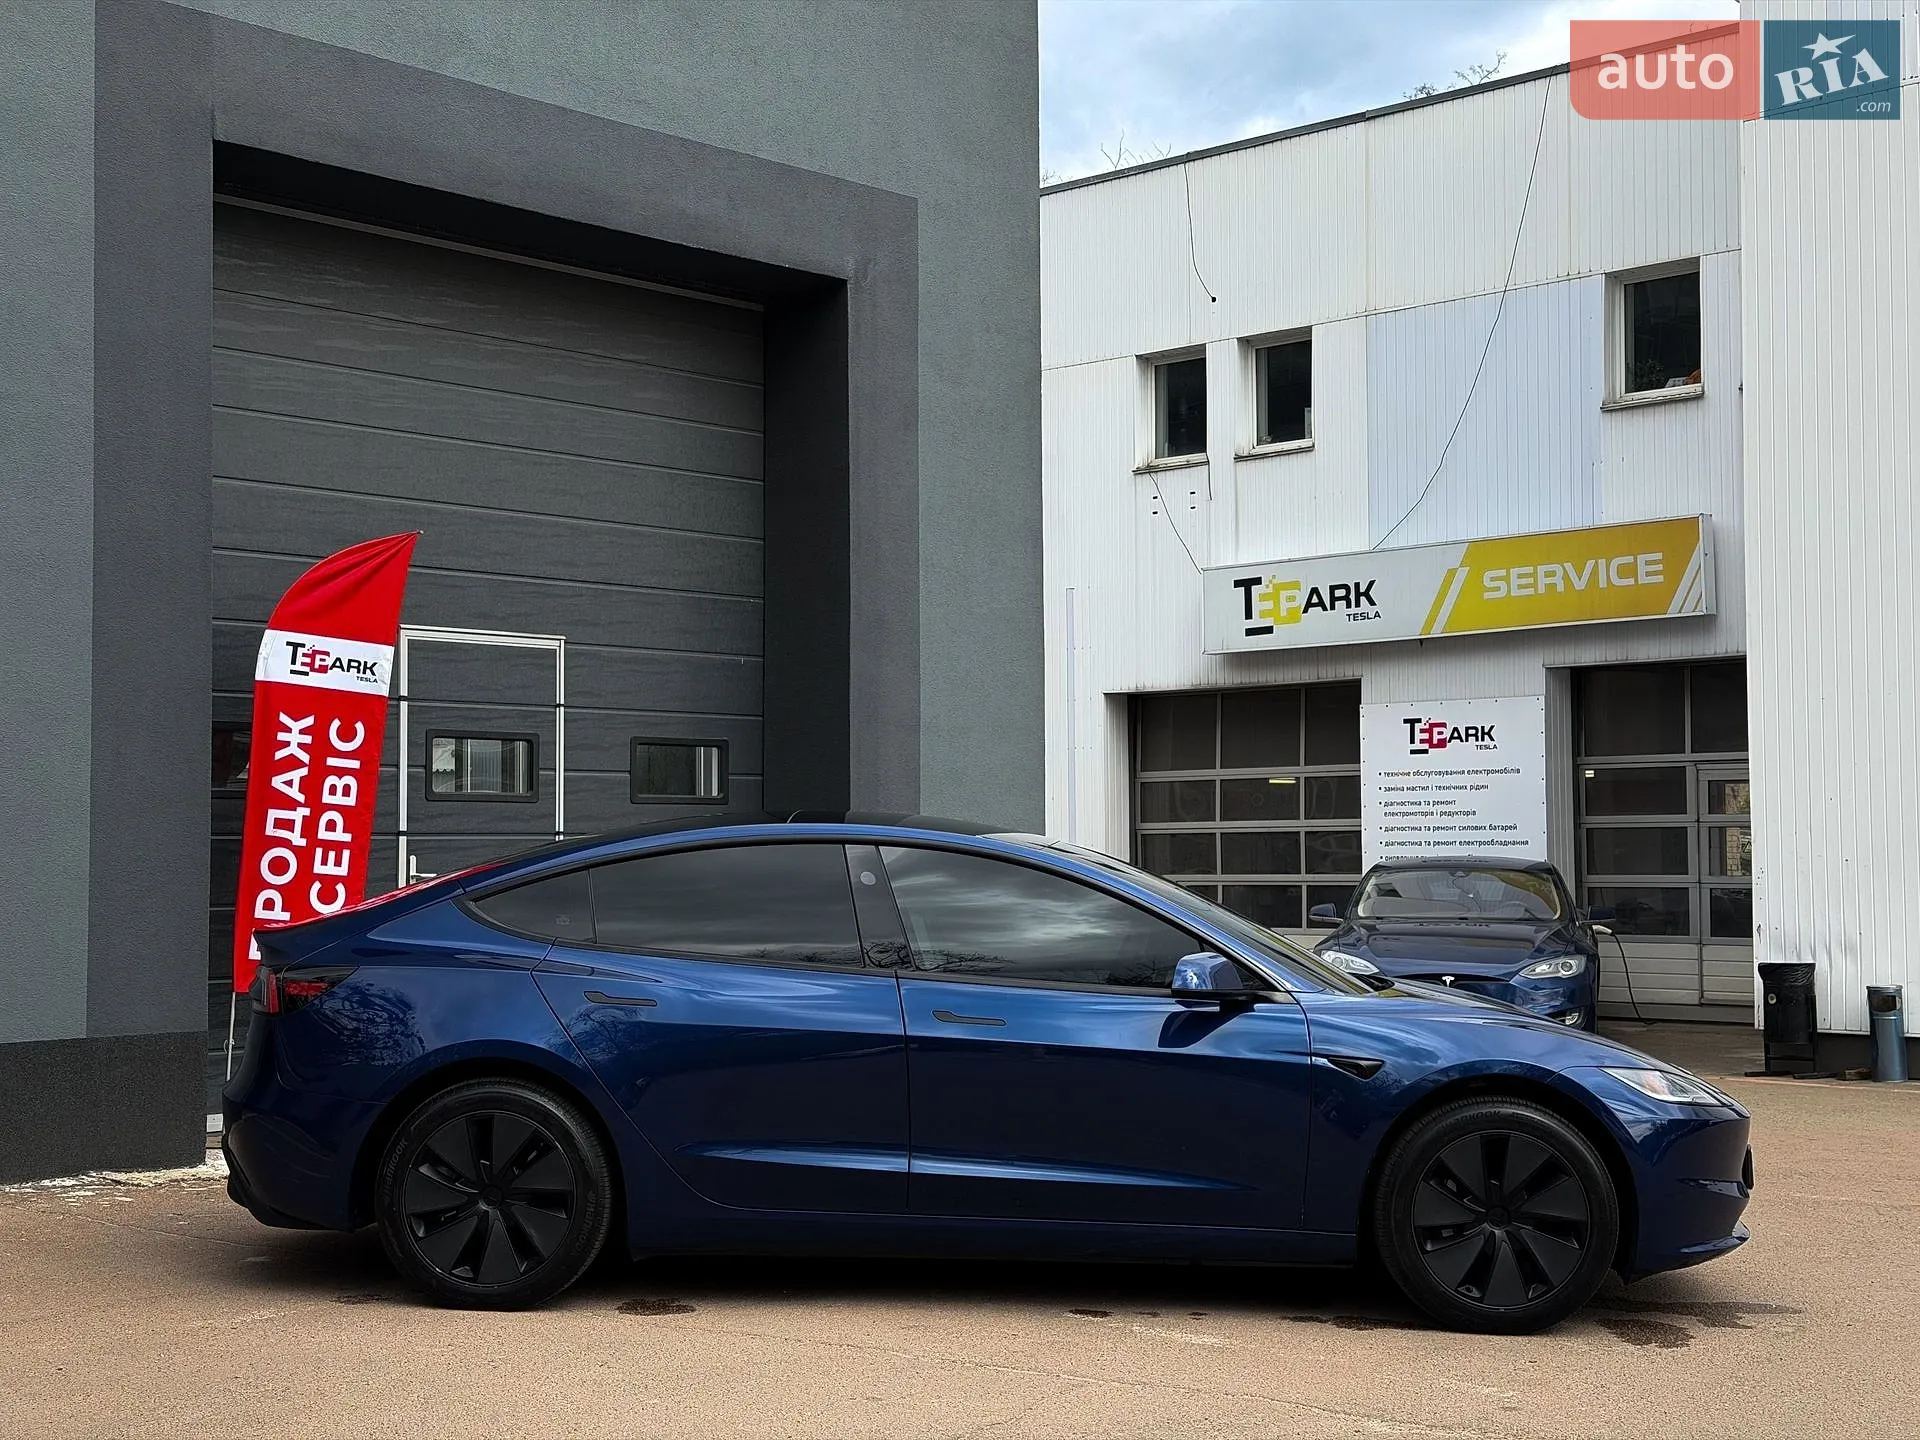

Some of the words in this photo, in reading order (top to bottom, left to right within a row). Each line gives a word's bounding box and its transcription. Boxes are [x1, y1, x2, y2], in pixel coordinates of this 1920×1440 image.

[1483, 552, 1664, 600] SERVICE
[1345, 610, 1381, 622] TESLA
[356, 674, 379, 684] TESLA
[1384, 770, 1411, 778] технічне
[1412, 768, 1466, 778] обслуговування
[1466, 767, 1521, 777] електромобілів
[1406, 784, 1430, 792] мастил
[1435, 783, 1468, 792] технічних
[1469, 783, 1489, 793] рідин
[1384, 799, 1422, 808] діагностика
[1432, 799, 1457, 808] ремонт
[309, 717, 365, 915] СЕРВІС
[1384, 810, 1435, 819] електромоторів
[1440, 808, 1477, 818] редукторів
[1384, 824, 1422, 833] діагностика
[1432, 825, 1457, 834] ремонт
[1458, 824, 1487, 832] силових
[1488, 823, 1518, 833] батарей
[248, 711, 315, 961] РОДАЖ
[1384, 839, 1423, 848] діагностика
[1432, 839, 1457, 848] ремонт
[1458, 838, 1530, 848] електрообладнання
